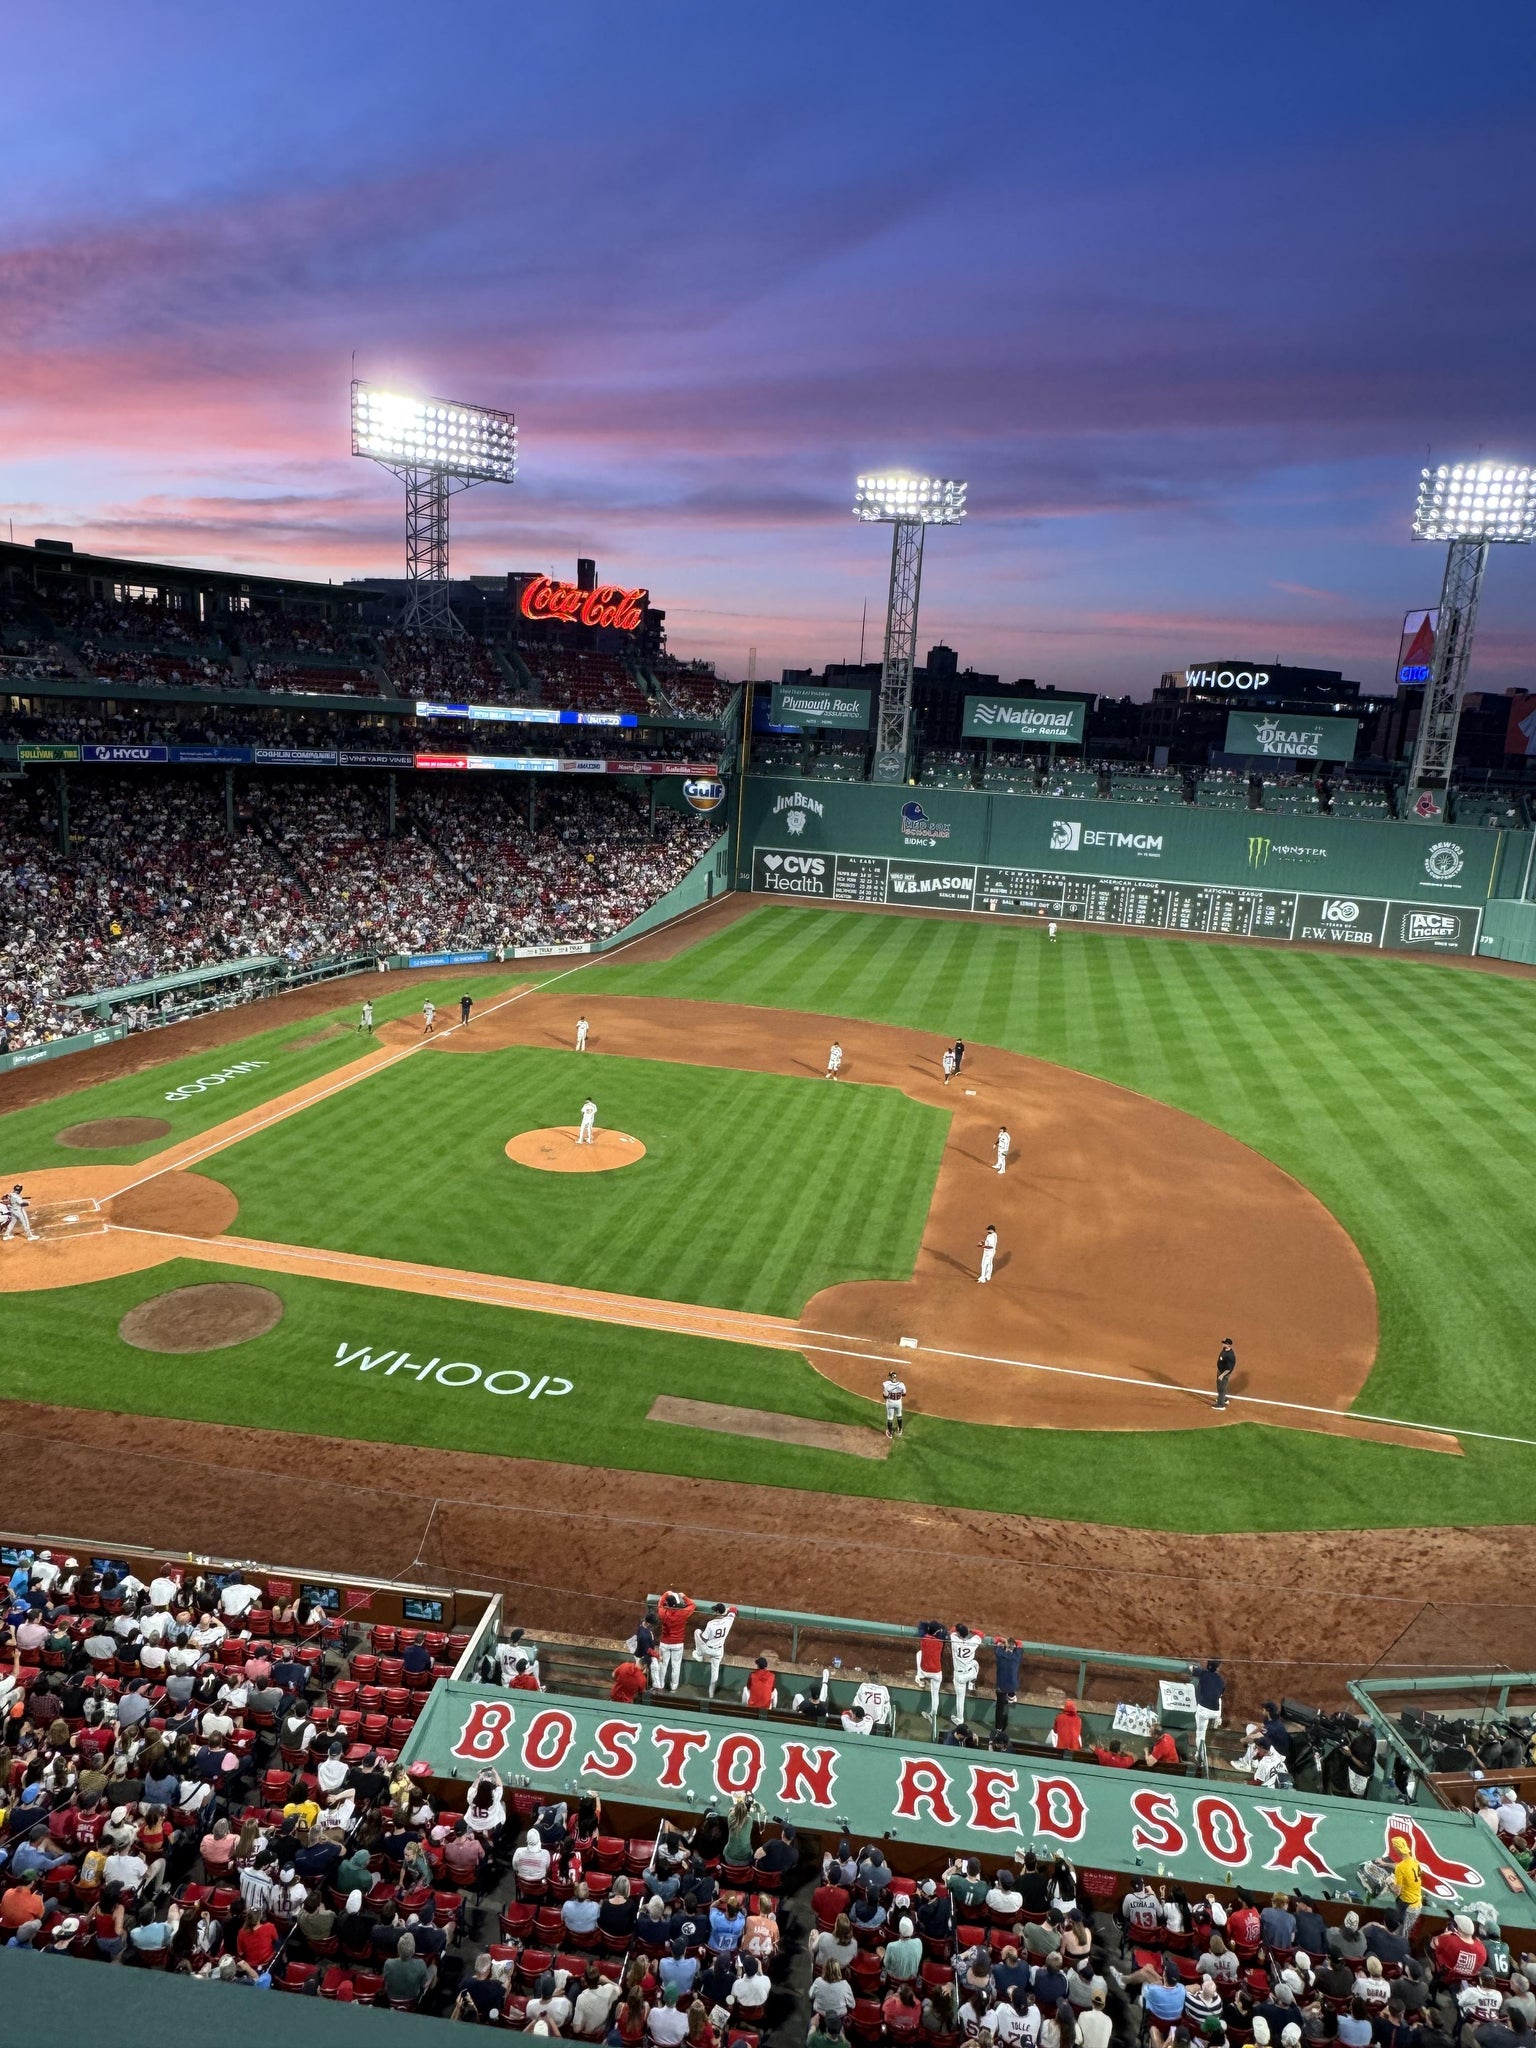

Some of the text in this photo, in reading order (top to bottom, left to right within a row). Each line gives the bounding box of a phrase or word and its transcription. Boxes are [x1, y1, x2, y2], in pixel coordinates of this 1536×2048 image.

[521, 577, 646, 630] Coca-Cola
[1185, 670, 1270, 690] WHOOP
[1401, 666, 1430, 682] CITG
[782, 696, 860, 712] Plymouth Rock
[1021, 726, 1068, 736] Car Rental
[1256, 729, 1323, 744] DRAFT
[20, 750, 54, 759] SULLIVAN
[113, 748, 149, 759] HYCU
[292, 751, 336, 759] COMPANIES
[1263, 742, 1318, 756] KINGS
[685, 782, 724, 798] Gulf
[773, 792, 824, 818] JIM BEAM
[904, 837, 928, 846] BIDMC
[1083, 830, 1163, 850] BETMGM
[1429, 841, 1452, 853] IBEW
[1272, 845, 1327, 857] MONSTER
[783, 856, 825, 875] CVS
[764, 872, 824, 893] Health
[1321, 900, 1360, 922] 160
[1413, 913, 1455, 928] ACE
[1301, 927, 1373, 944] F.W. WEBB
[1413, 928, 1454, 937] TICKET
[1480, 935, 1494, 944] 379
[27, 1051, 47, 1062] TICKET
[165, 1061, 270, 1101] WHOOP
[333, 1342, 574, 1400] WHOOP
[714, 1627, 726, 1639] 81
[957, 1647, 971, 1658] 12
[503, 1655, 516, 1666] 17
[451, 1700, 1346, 1881] BOSTON RED SOX
[1083, 1872, 1117, 1881] CAUTION!
[965, 1892, 974, 1906] 11
[1135, 1911, 1153, 1927] 13
[749, 1937, 773, 1955] 44
[1494, 1953, 1509, 1973] 16
[1011, 2021, 1031, 2032] TOLLE
